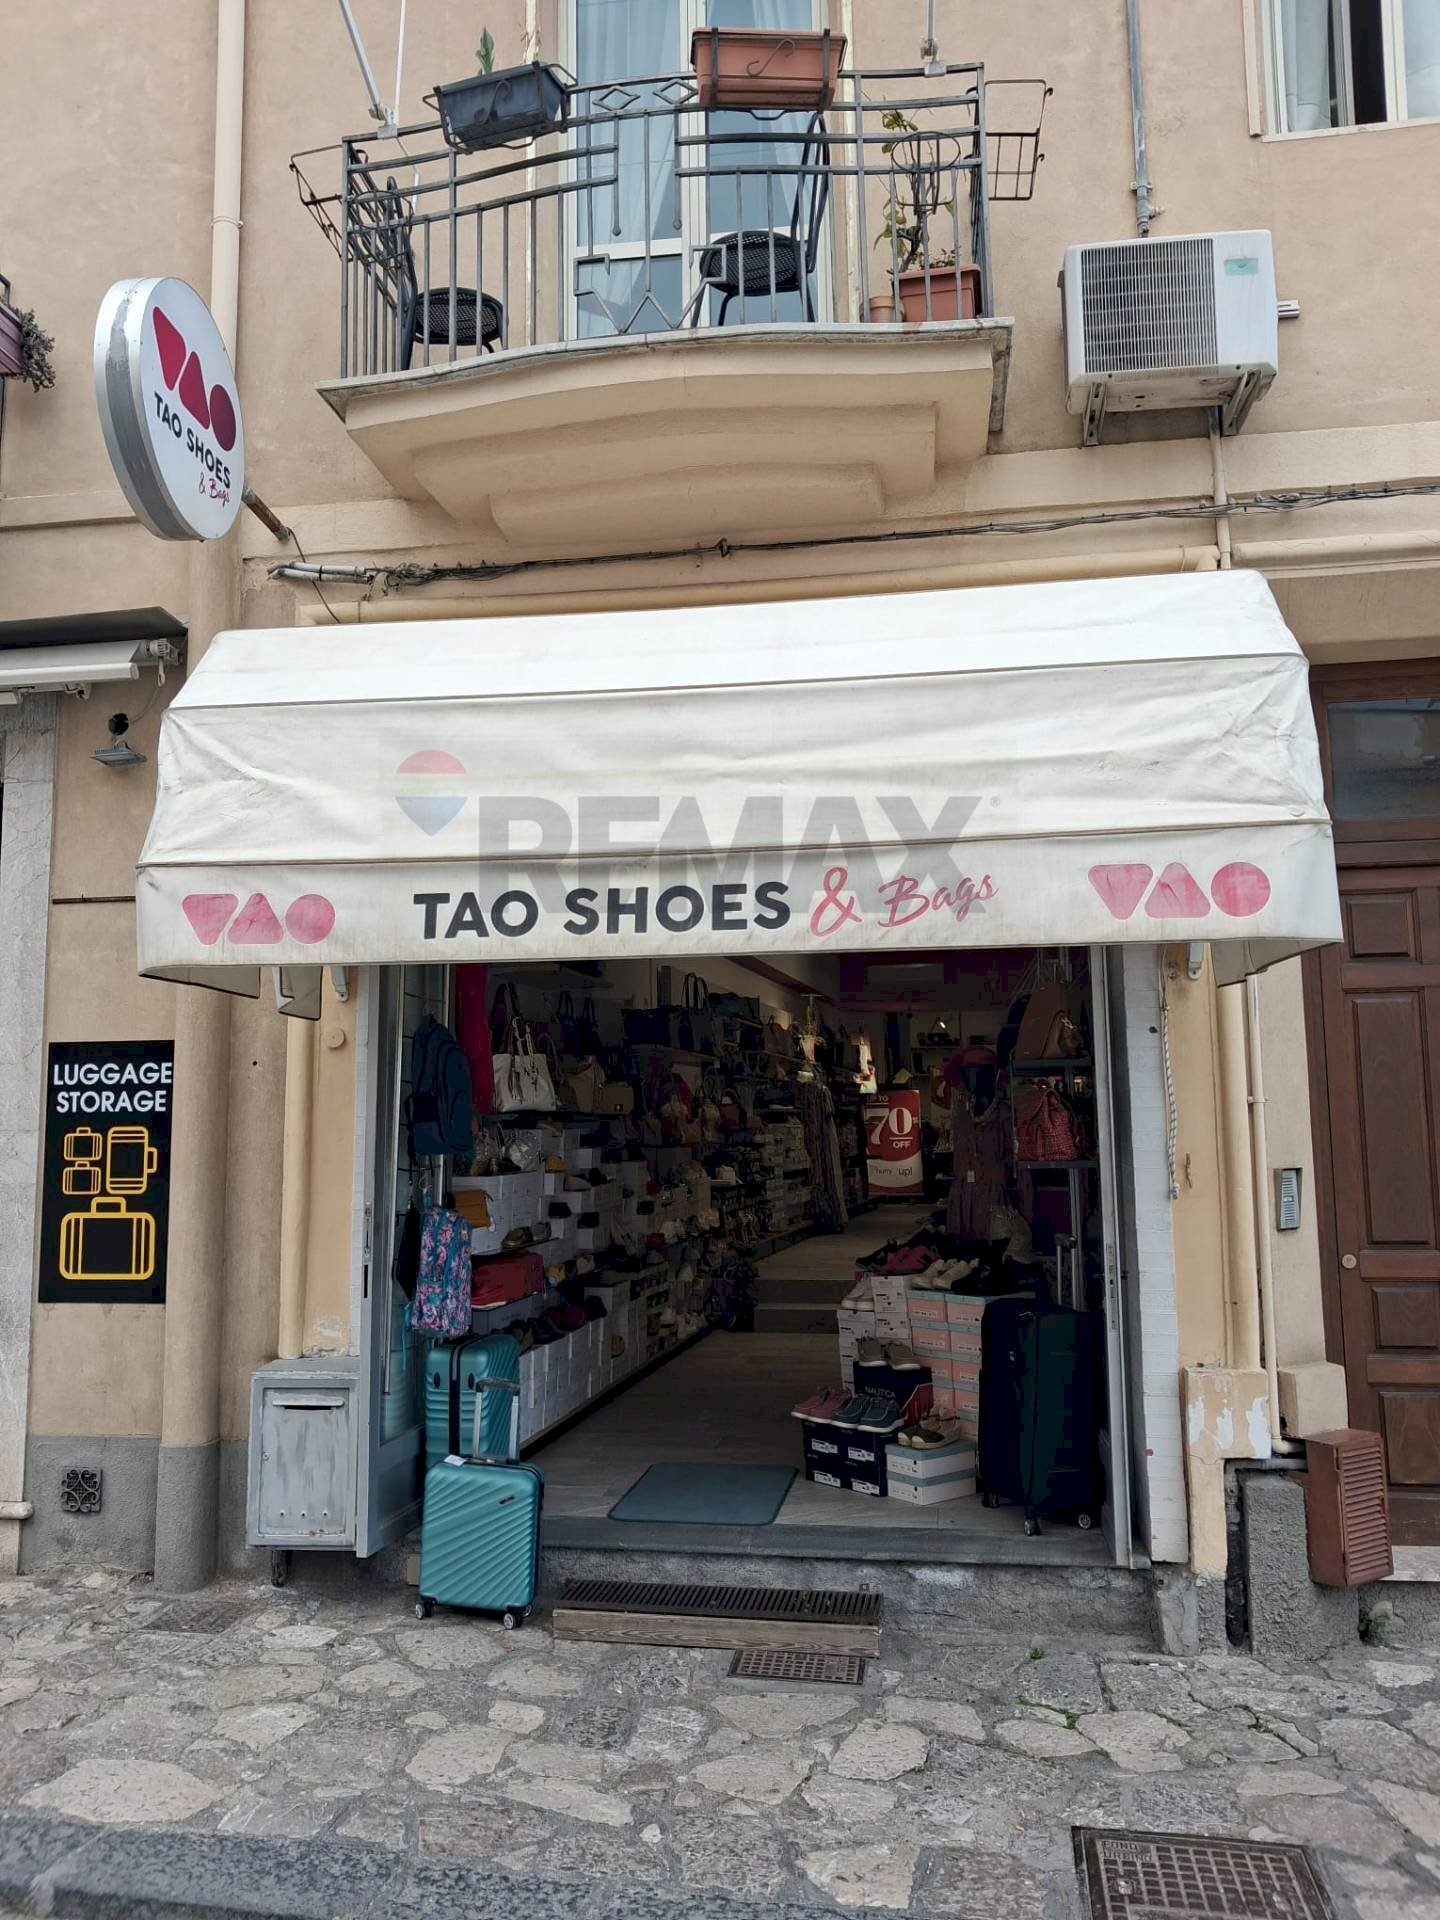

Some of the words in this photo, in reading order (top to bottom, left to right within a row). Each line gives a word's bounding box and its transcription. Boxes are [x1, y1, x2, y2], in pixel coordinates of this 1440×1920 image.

[154, 391, 182, 438] TAO
[187, 427, 231, 489] SHOES
[199, 472, 206, 494] &
[209, 478, 231, 507] Bags
[413, 890, 539, 940] TAO
[563, 880, 791, 936] SHOES
[810, 866, 863, 937] &
[877, 873, 999, 928] Bags
[53, 1062, 173, 1087] LUGGAGE
[56, 1090, 167, 1114] STORAGE
[892, 1140, 912, 1149] OFF
